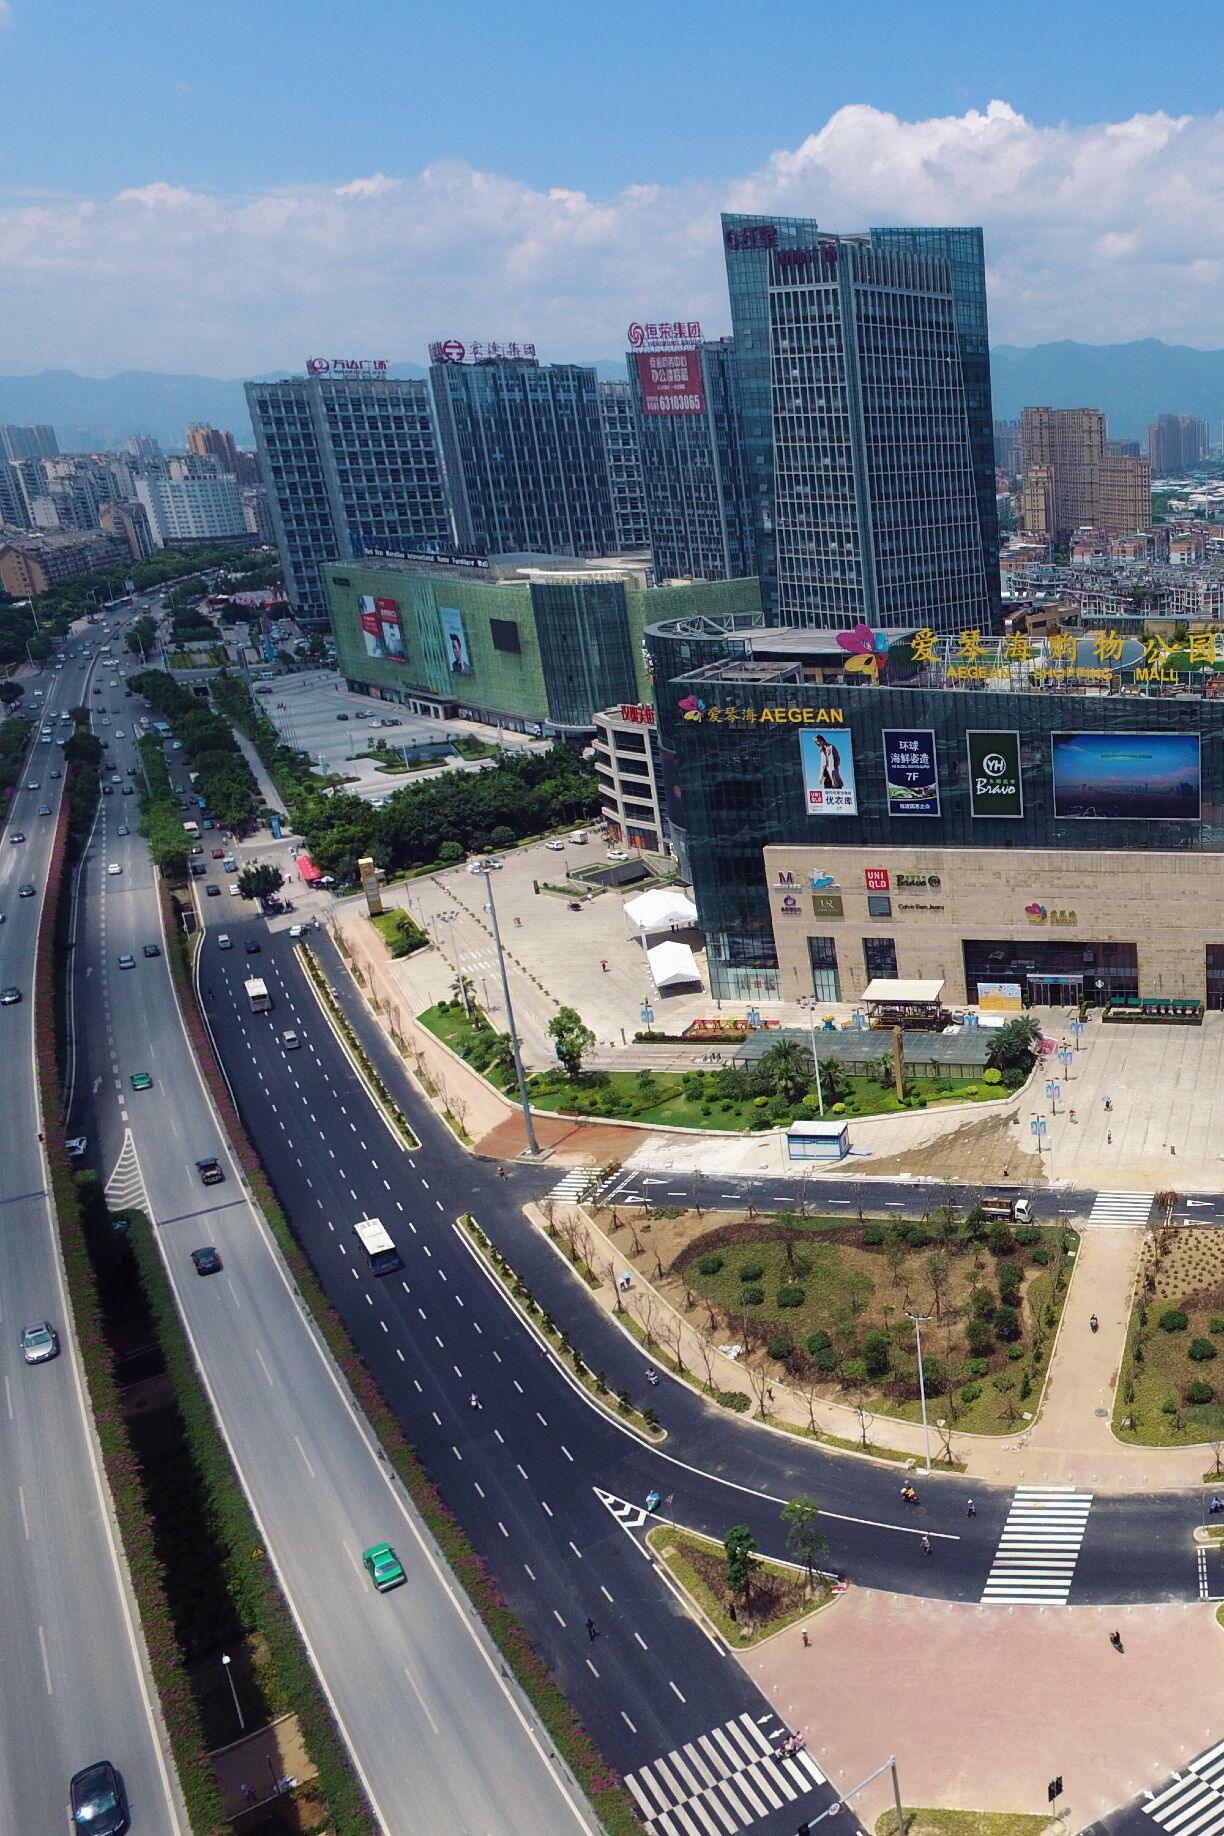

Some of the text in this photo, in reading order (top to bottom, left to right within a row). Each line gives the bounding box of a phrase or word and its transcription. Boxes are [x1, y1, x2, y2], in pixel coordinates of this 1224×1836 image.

[646, 322, 700, 338] 恒荣集团
[333, 359, 387, 370] 万达广场
[660, 395, 701, 410] 63103065
[911, 628, 1217, 664] 爱琴海购物公园
[947, 666, 1179, 682] AEGEAN SHOPPING MALL
[708, 706, 844, 724] 爱琴海 AEGEAN
[899, 740, 920, 751] 环球
[905, 772, 920, 781] 7F
[975, 777, 1017, 795] Bravo
[826, 796, 853, 806] 优衣库
[867, 871, 884, 880] UNI
[868, 880, 887, 888] QLO
[821, 899, 834, 909] UR
